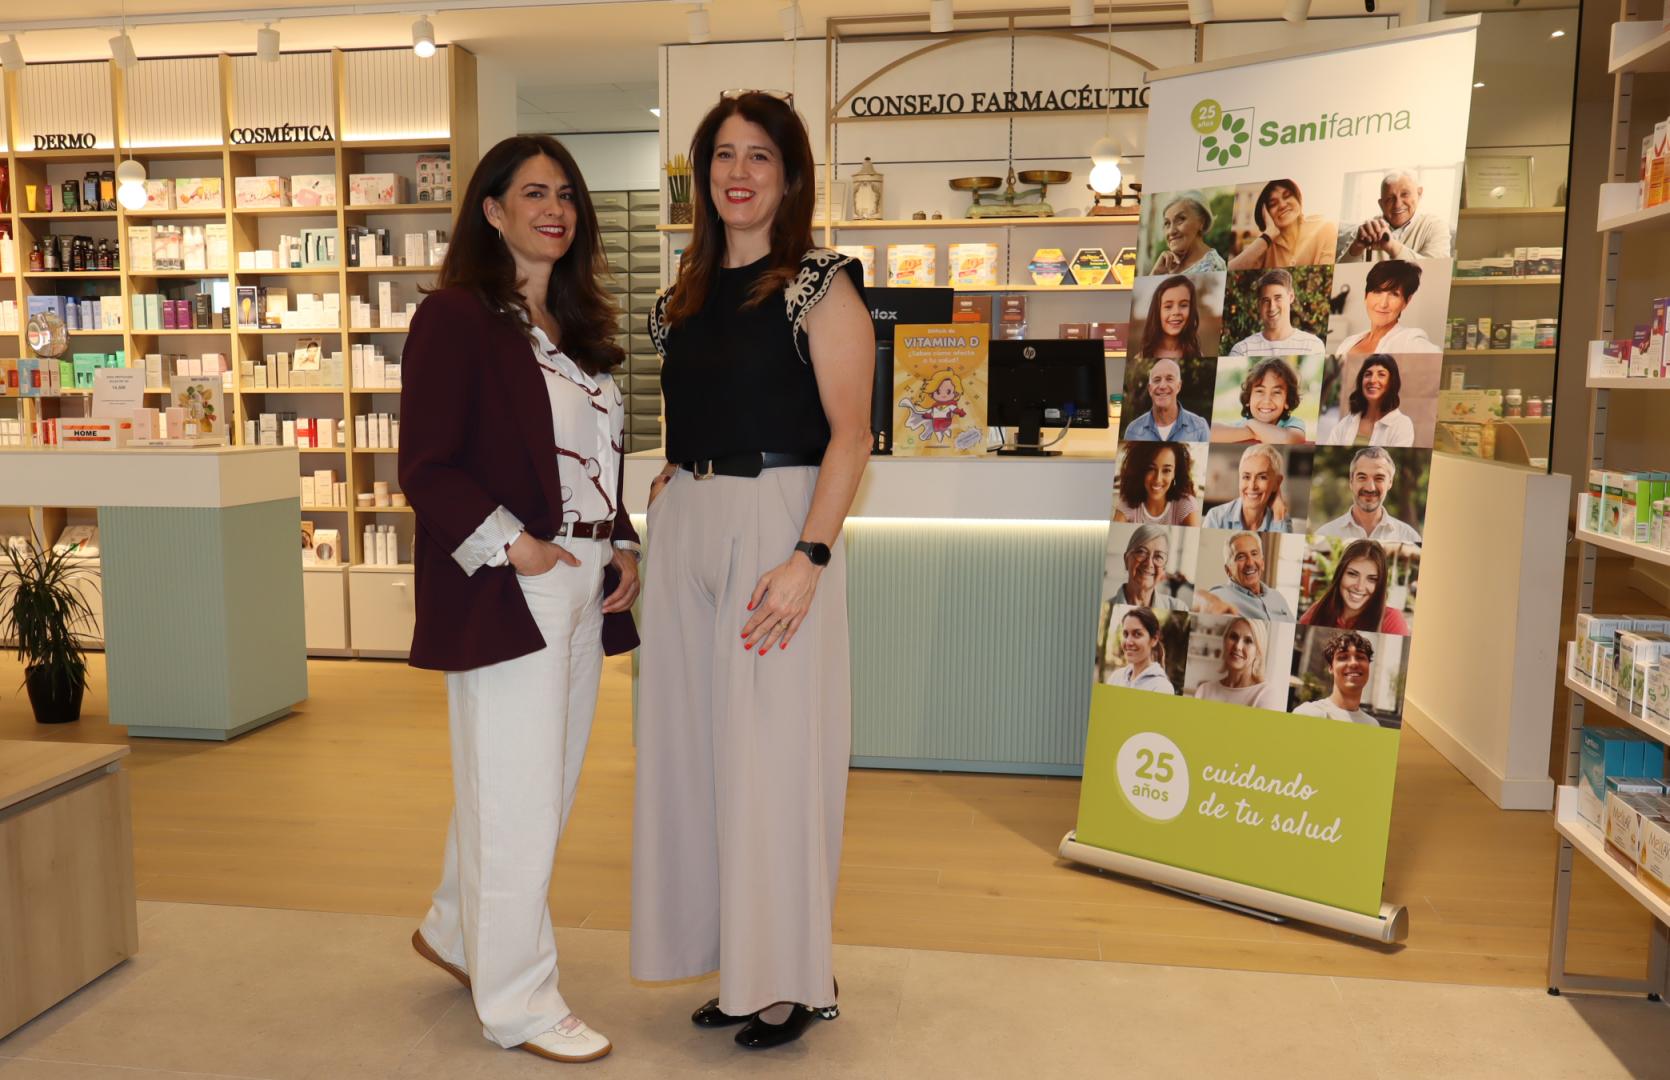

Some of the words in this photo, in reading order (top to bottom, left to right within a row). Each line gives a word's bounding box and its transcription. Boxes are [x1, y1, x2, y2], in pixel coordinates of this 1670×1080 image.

[851, 93, 964, 117] CONSEJO
[972, 84, 1151, 113] FARMACÉUTIC
[1199, 105, 1217, 120] 25
[33, 133, 97, 150] DERMO
[230, 122, 334, 144] COSMÉTICA
[1259, 110, 1411, 147] Sanifarma
[904, 336, 966, 349] VITAMINA
[969, 336, 980, 349] D
[1135, 748, 1175, 783] 25
[1131, 783, 1169, 802] años
[1202, 763, 1318, 801] cuidando
[1198, 792, 1229, 819] de
[1235, 798, 1264, 826] tu
[1271, 811, 1342, 844] salud
